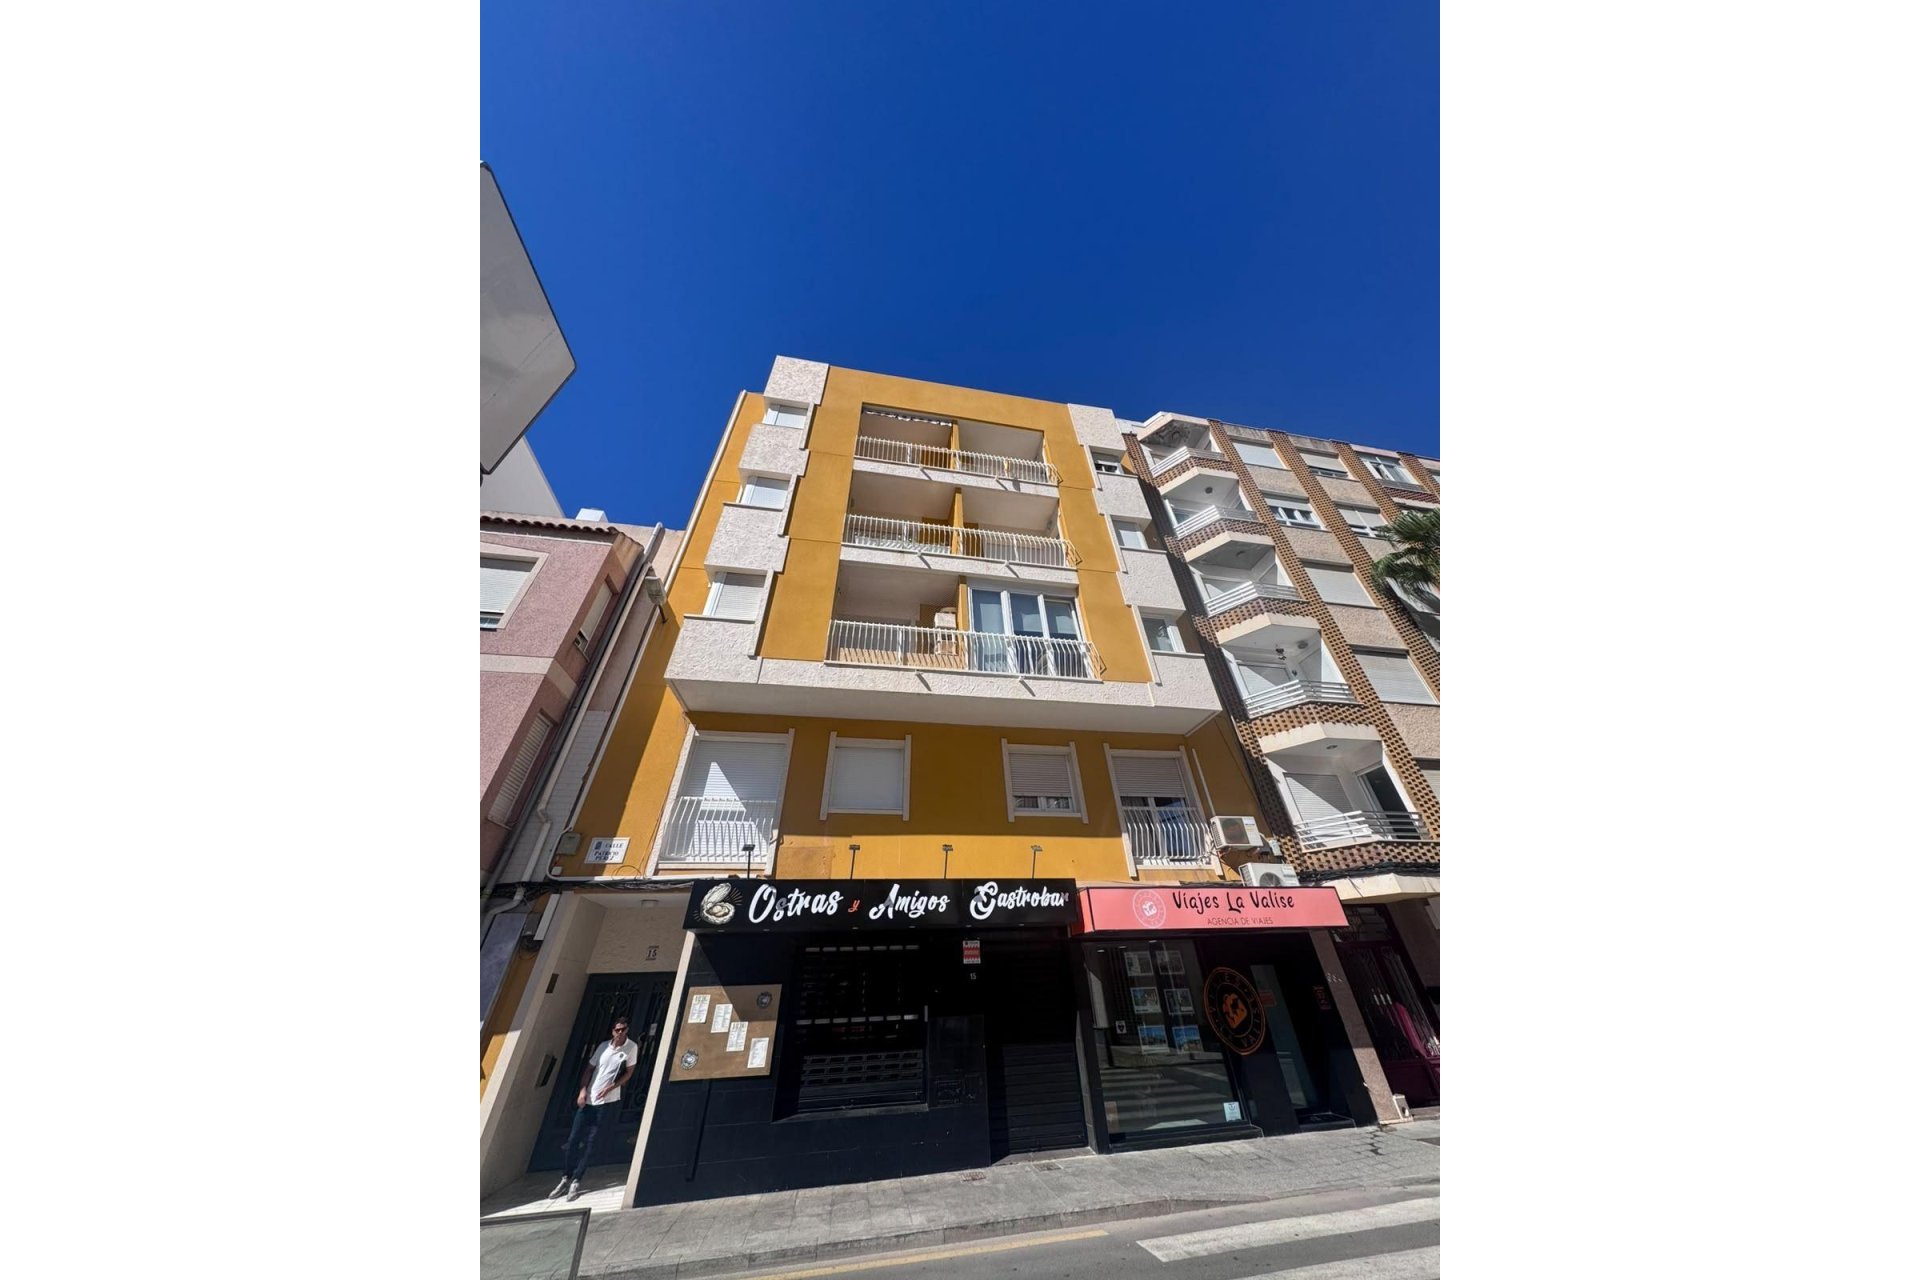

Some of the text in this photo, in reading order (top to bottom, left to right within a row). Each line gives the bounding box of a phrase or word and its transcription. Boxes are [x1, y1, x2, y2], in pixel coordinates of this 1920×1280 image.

[748, 881, 1069, 923] Ostras y Amigos Gastrobar
[1172, 890, 1220, 915] Viajes
[1226, 891, 1245, 914] La
[1249, 890, 1295, 909] Valise
[1207, 916, 1274, 926] AGENCIA DE VIAJES
[970, 972, 977, 980] 15
